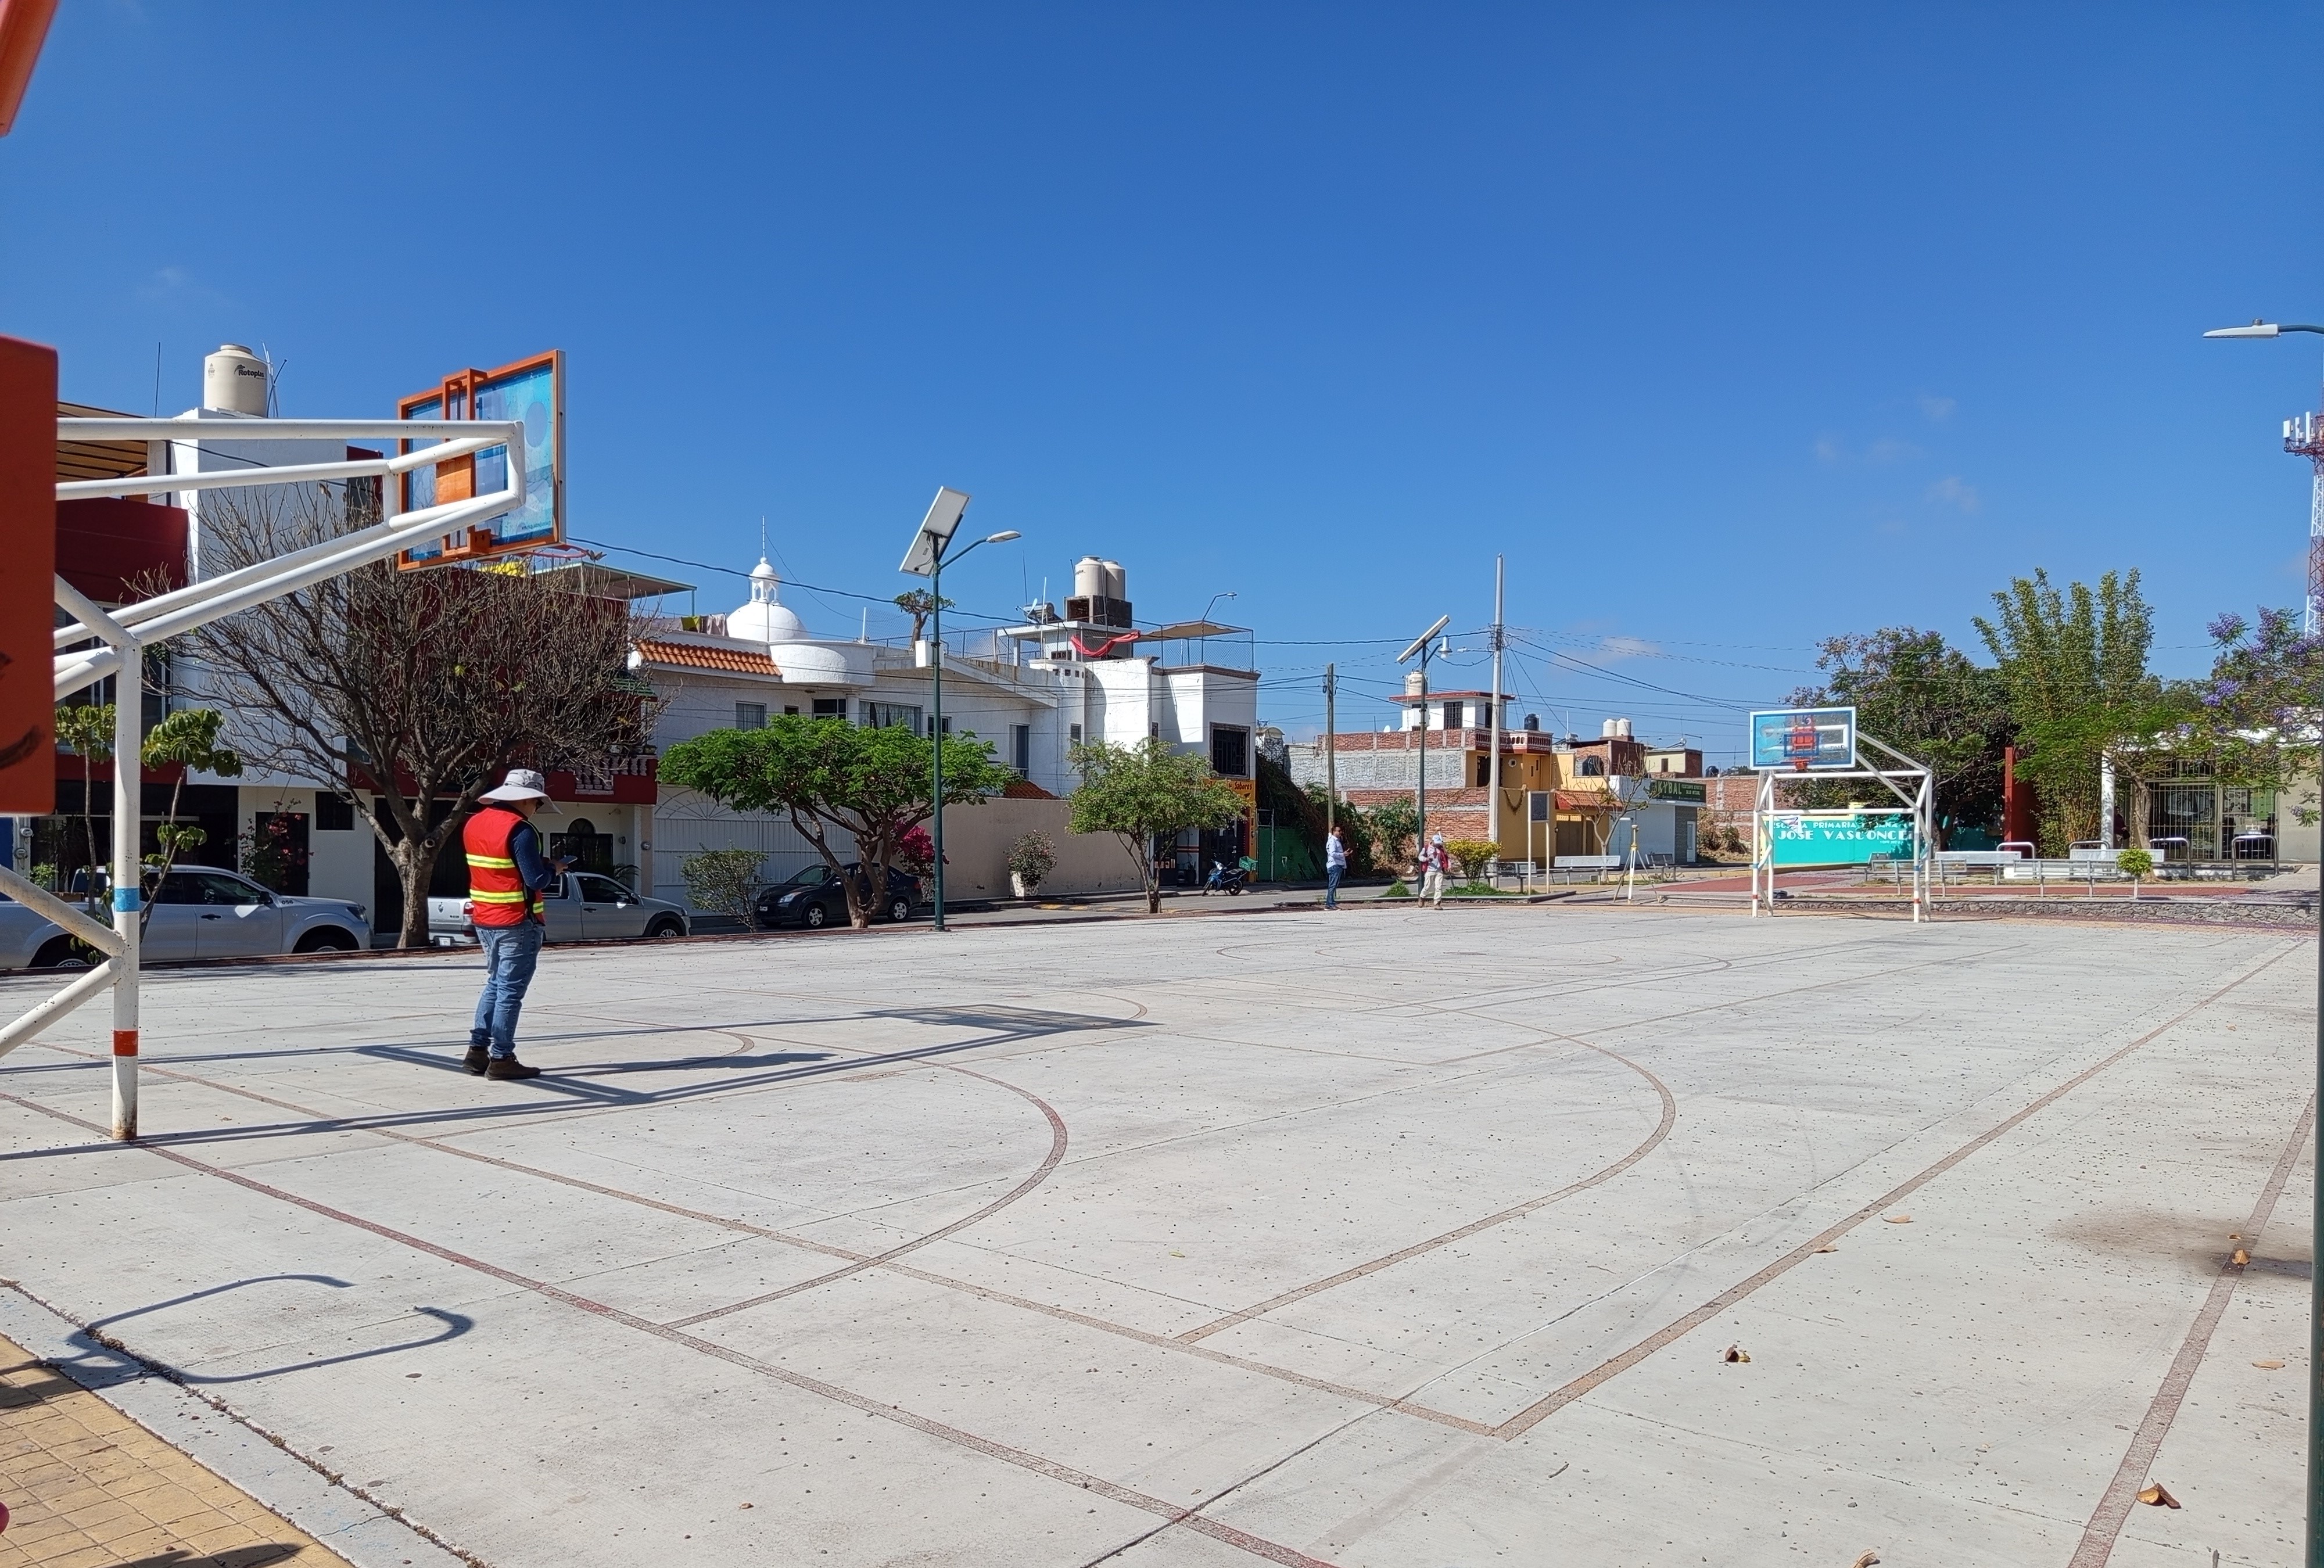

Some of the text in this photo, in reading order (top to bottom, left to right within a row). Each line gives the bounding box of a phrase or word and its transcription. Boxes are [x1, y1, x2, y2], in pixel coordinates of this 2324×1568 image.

[238, 369, 264, 378] Rotoplas
[1234, 781, 1252, 790] Sabores
[1777, 830, 1814, 840] JOSE
